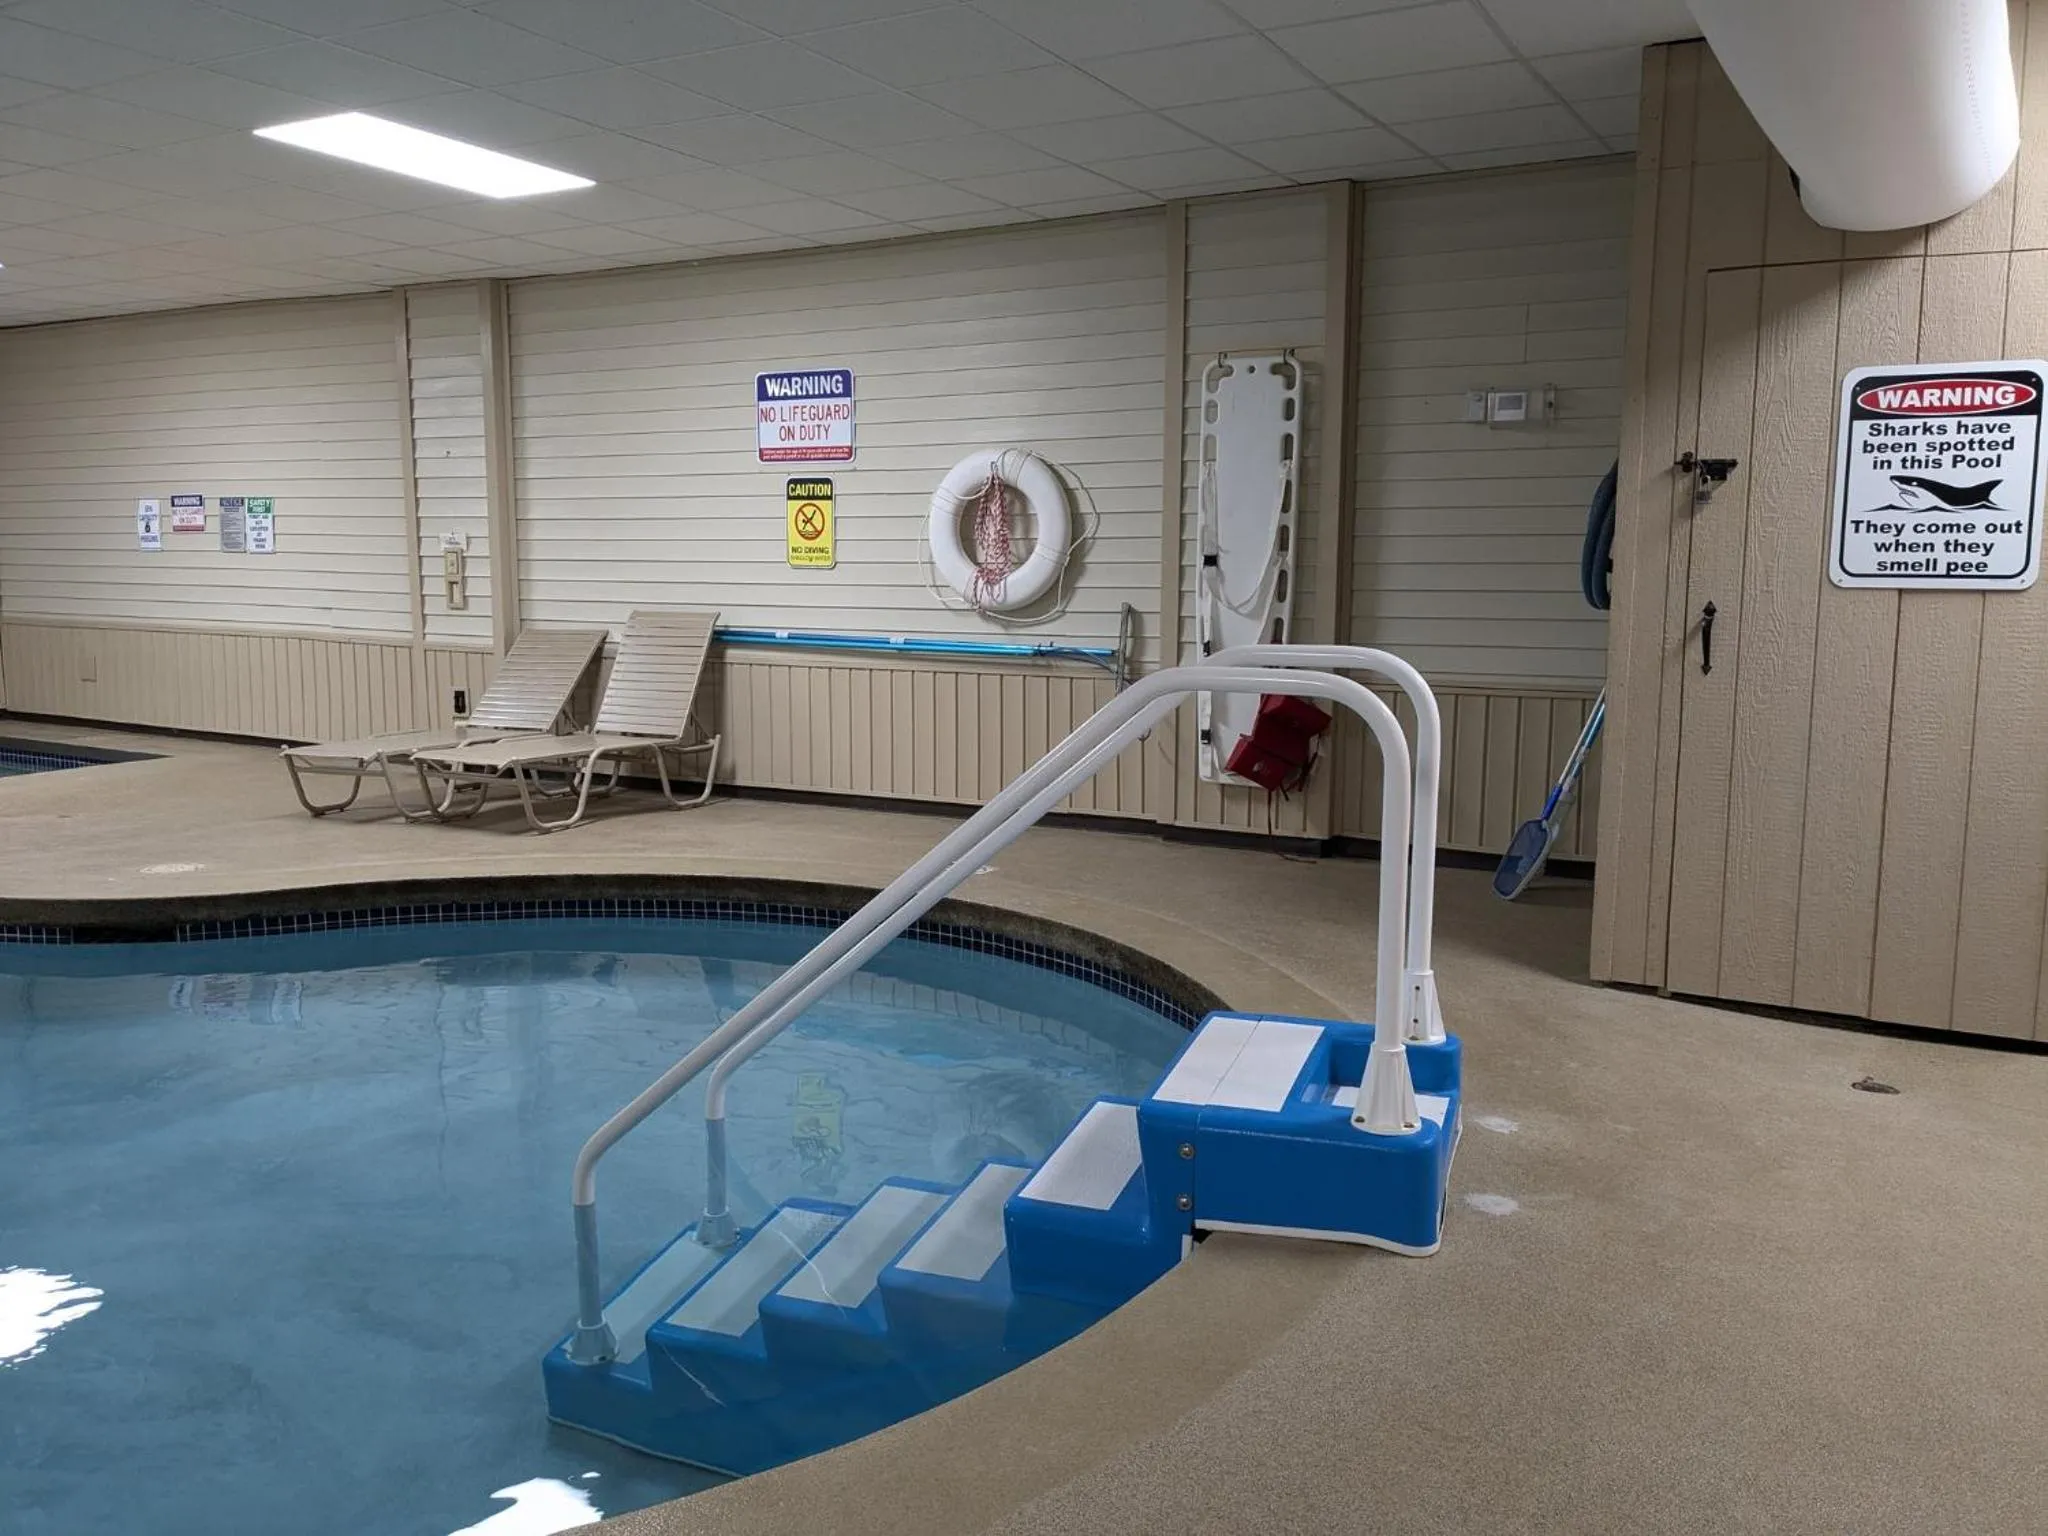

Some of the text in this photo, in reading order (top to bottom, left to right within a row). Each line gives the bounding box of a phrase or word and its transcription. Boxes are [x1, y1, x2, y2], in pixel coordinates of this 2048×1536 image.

[765, 374, 844, 397] WARNING
[1877, 386, 2016, 409] WARNING
[760, 404, 850, 422] NO LIFEGUARD
[779, 424, 831, 441] ON DUTY
[1868, 420, 2011, 437] Sharks have
[1862, 437, 2015, 455] been spotted
[1872, 454, 2001, 470] in this Pool
[788, 483, 831, 496] CAUTION
[173, 496, 200, 507] WARNING
[1850, 519, 2023, 537] They come out
[791, 546, 830, 554] NO DIVING
[1874, 538, 1995, 556] when they
[1876, 558, 1989, 575] smell pee
